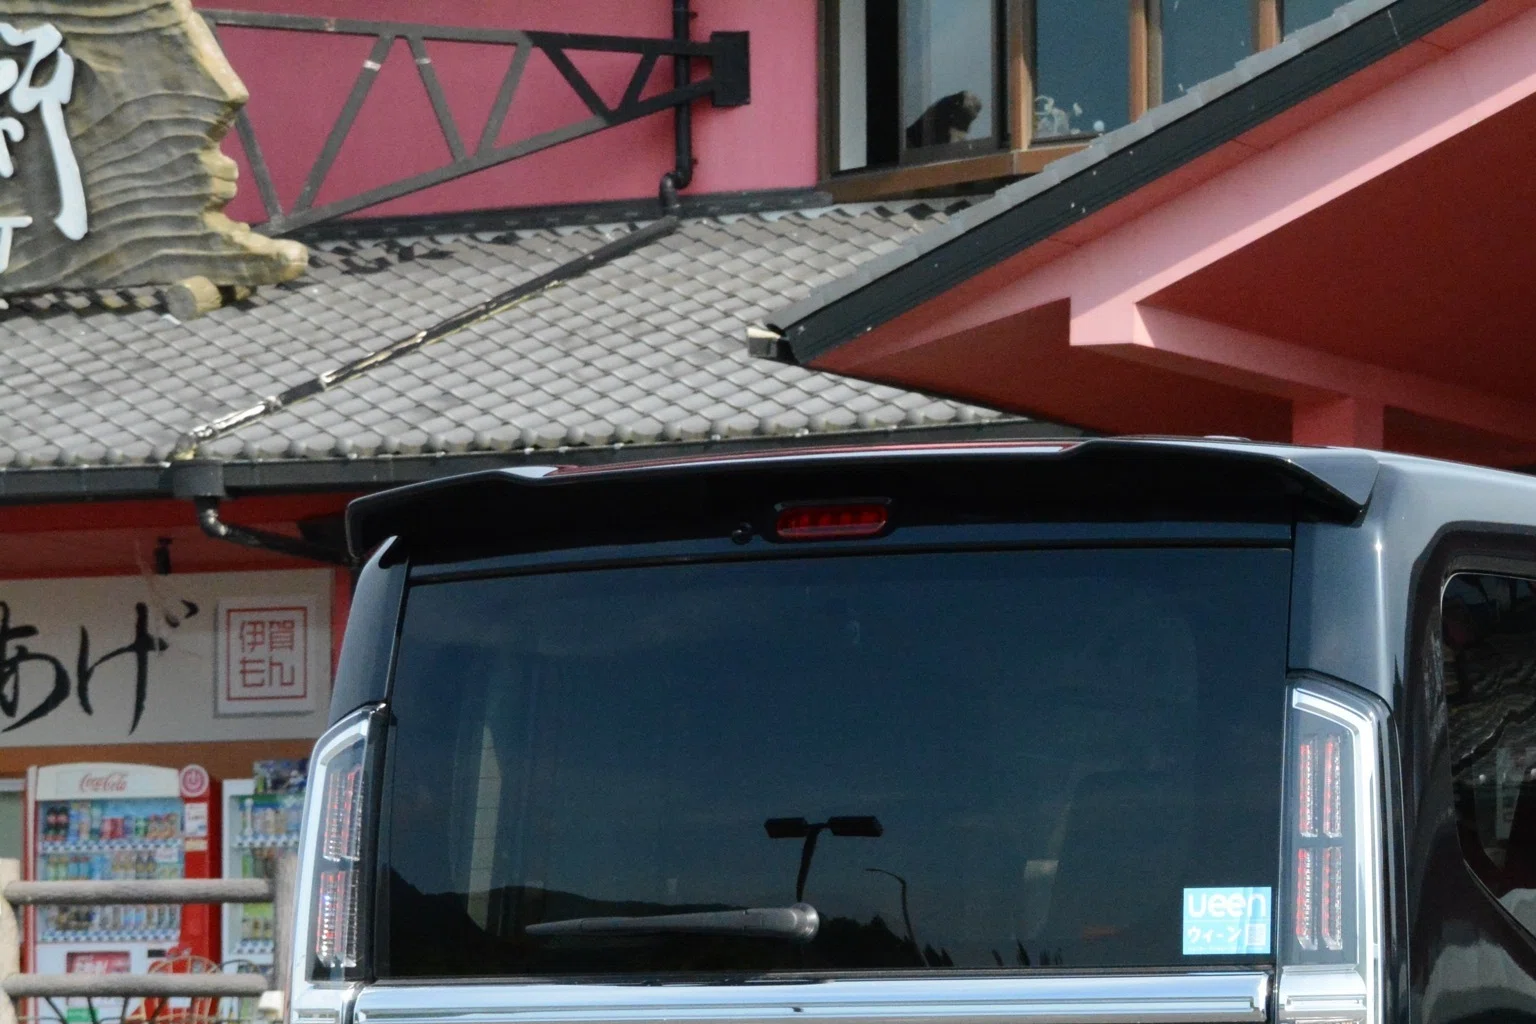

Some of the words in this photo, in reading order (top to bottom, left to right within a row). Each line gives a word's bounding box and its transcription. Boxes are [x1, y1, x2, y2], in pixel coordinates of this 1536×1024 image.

[239, 620, 296, 653] 伊賀
[239, 656, 296, 688] もん
[1188, 893, 1267, 918] ueen
[1187, 926, 1242, 944] ウィーン
